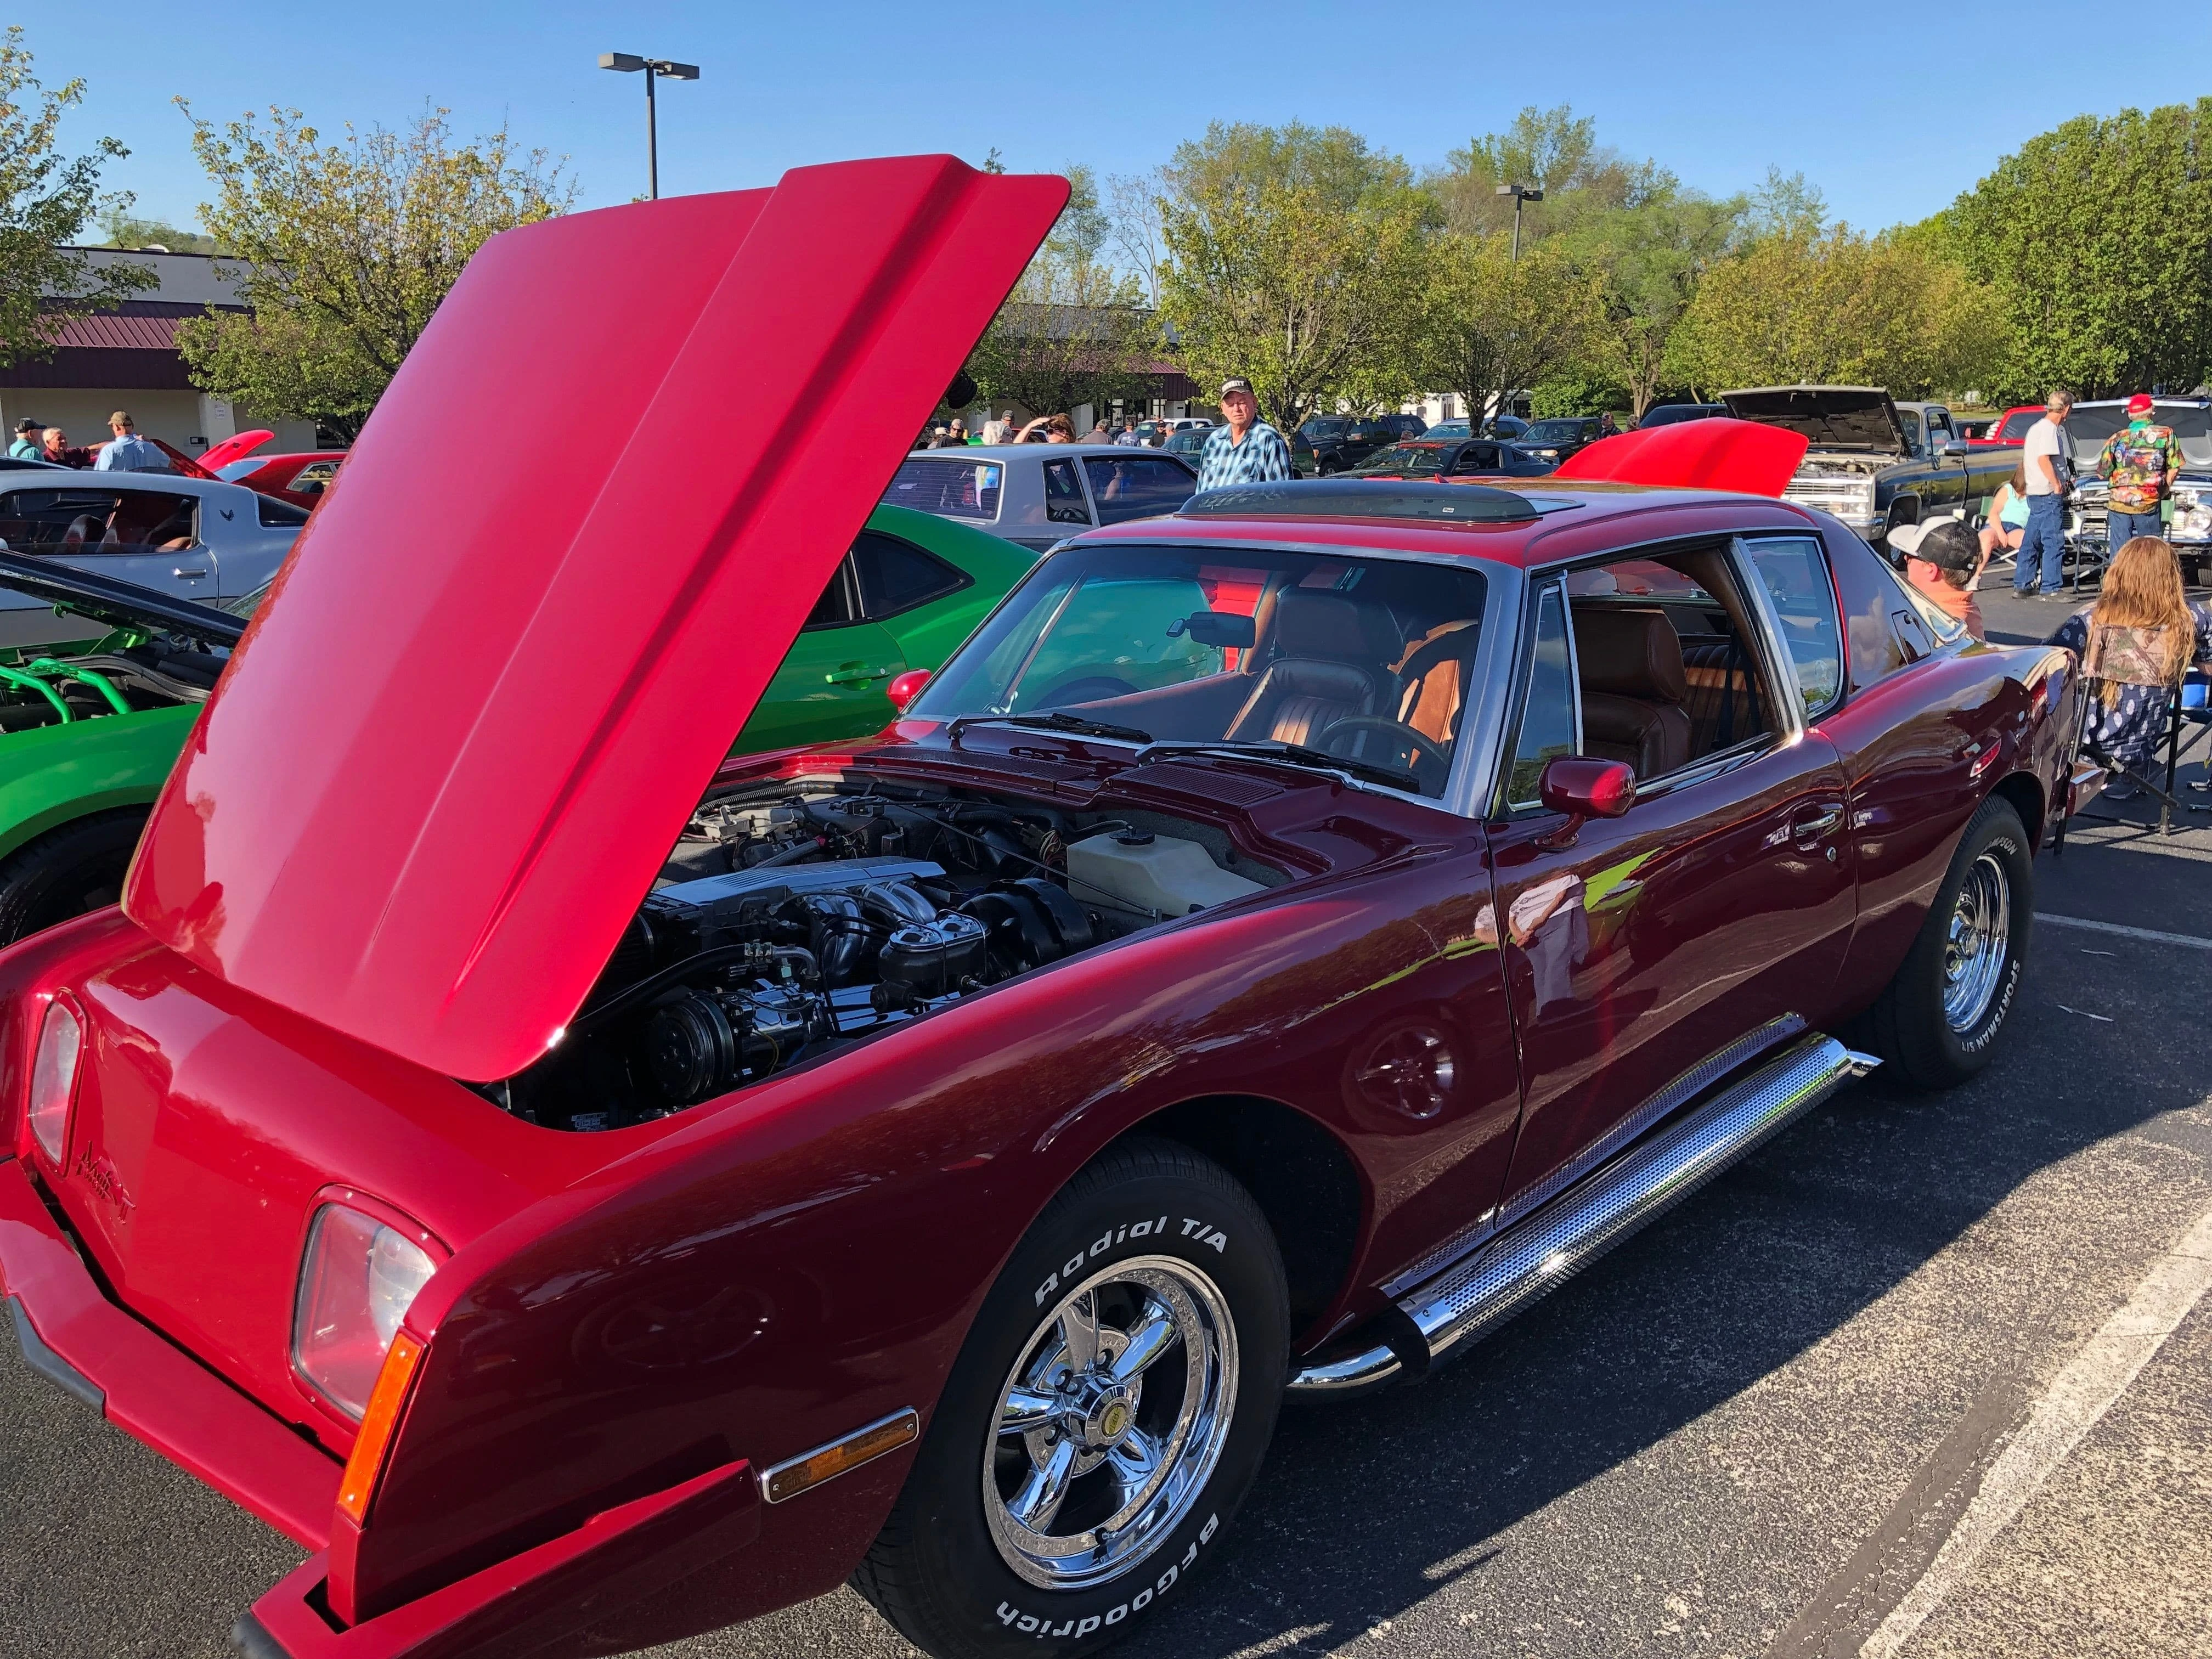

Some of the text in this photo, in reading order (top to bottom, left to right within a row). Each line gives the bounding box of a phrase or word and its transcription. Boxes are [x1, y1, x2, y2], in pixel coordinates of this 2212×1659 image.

[1976, 960, 2021, 1049] SPORTSMAN
[1035, 1216, 1227, 1308] Radial T/A
[996, 1512, 1219, 1639] BFGoodrich
